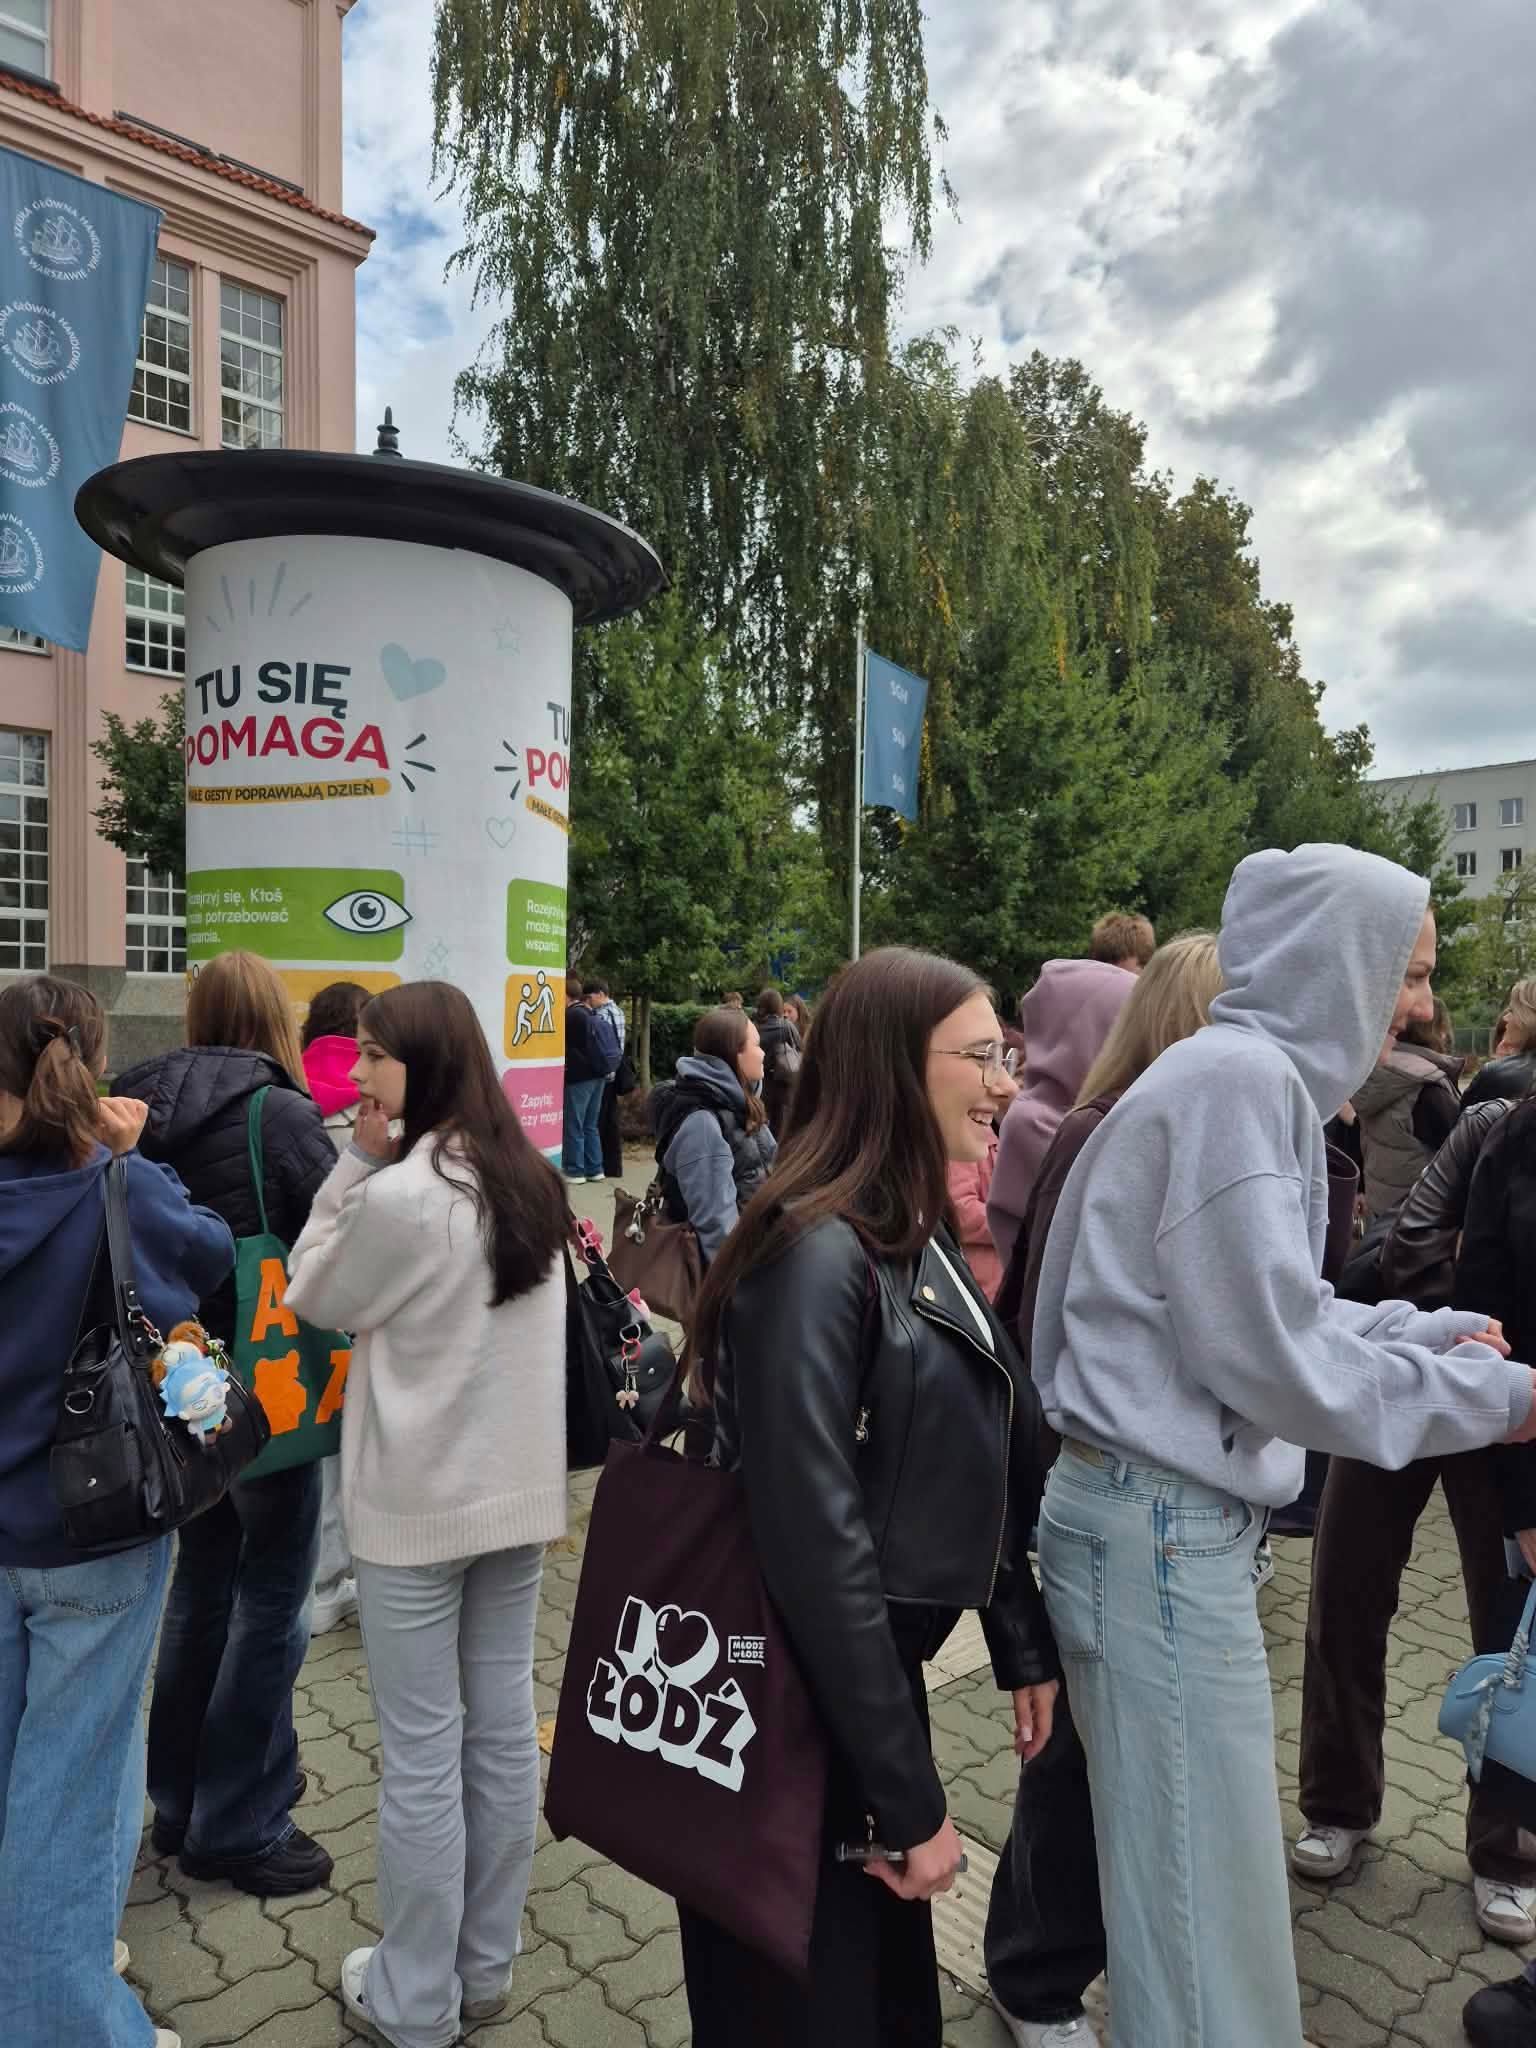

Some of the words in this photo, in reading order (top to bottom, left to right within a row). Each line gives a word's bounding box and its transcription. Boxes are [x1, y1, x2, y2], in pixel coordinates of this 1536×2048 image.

[195, 664, 241, 715] TU
[257, 661, 352, 719] SIĘ
[185, 714, 391, 776] POMAGA
[546, 701, 570, 746] TU
[204, 789, 233, 802] GESTY
[234, 785, 324, 801] POPRAWIAJĄ
[327, 778, 375, 797] DZIEŃ
[205, 907, 289, 926] potrzebować
[250, 887, 284, 904] Ktoś
[250, 1258, 299, 1342] A
[587, 1656, 757, 1792] ŁÓDŹ
